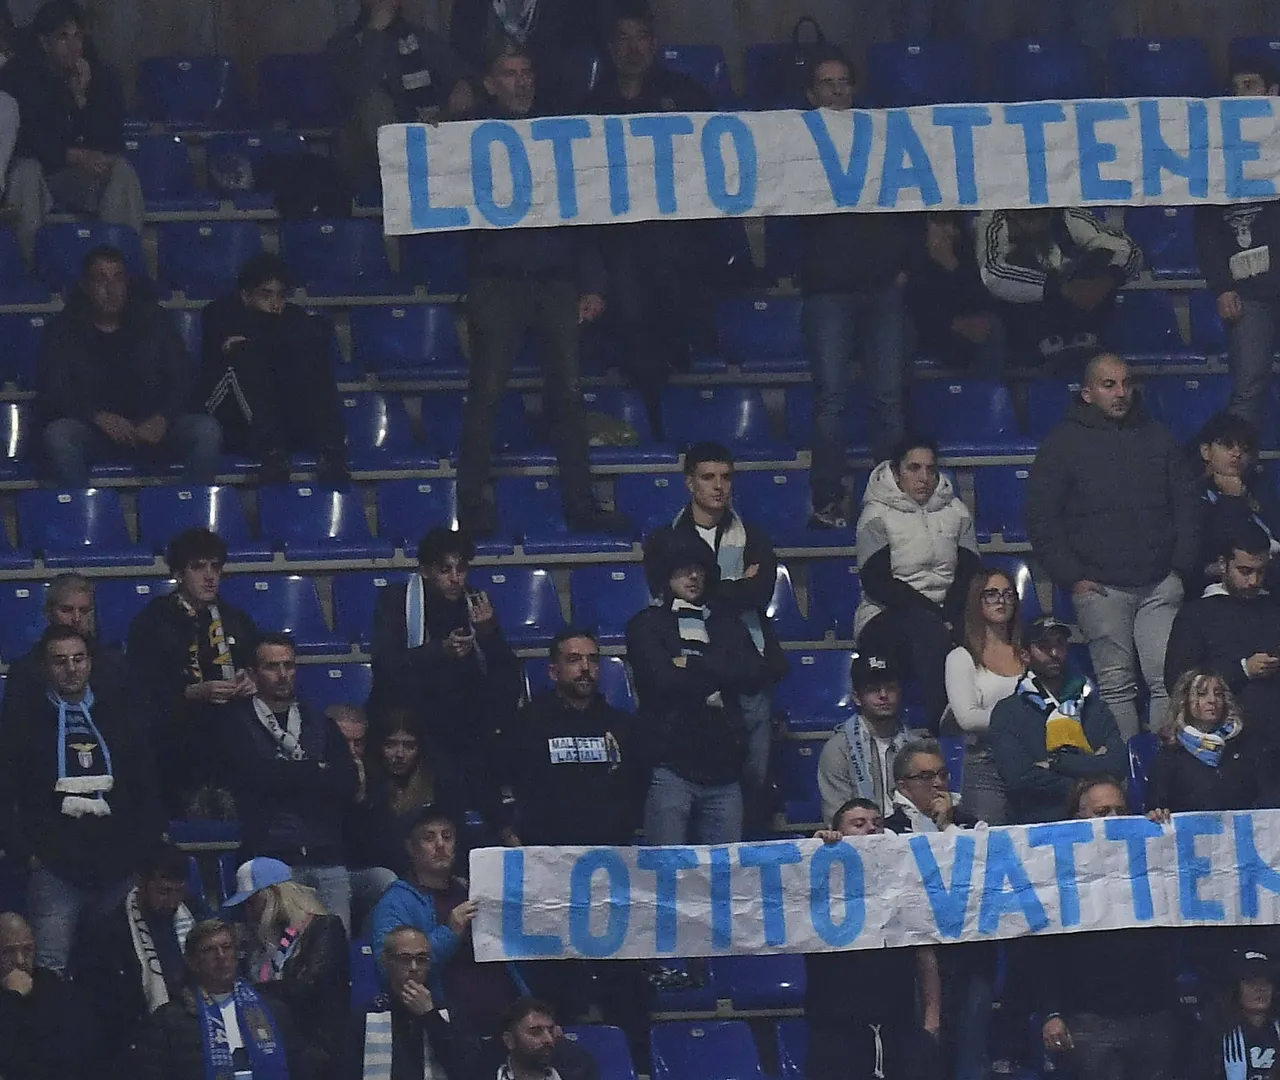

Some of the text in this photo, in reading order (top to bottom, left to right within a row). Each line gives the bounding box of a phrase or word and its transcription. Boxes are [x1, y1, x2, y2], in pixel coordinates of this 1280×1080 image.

[406, 98, 1276, 229] LOTITO VATTENE
[500, 840, 867, 958] LOTITO
